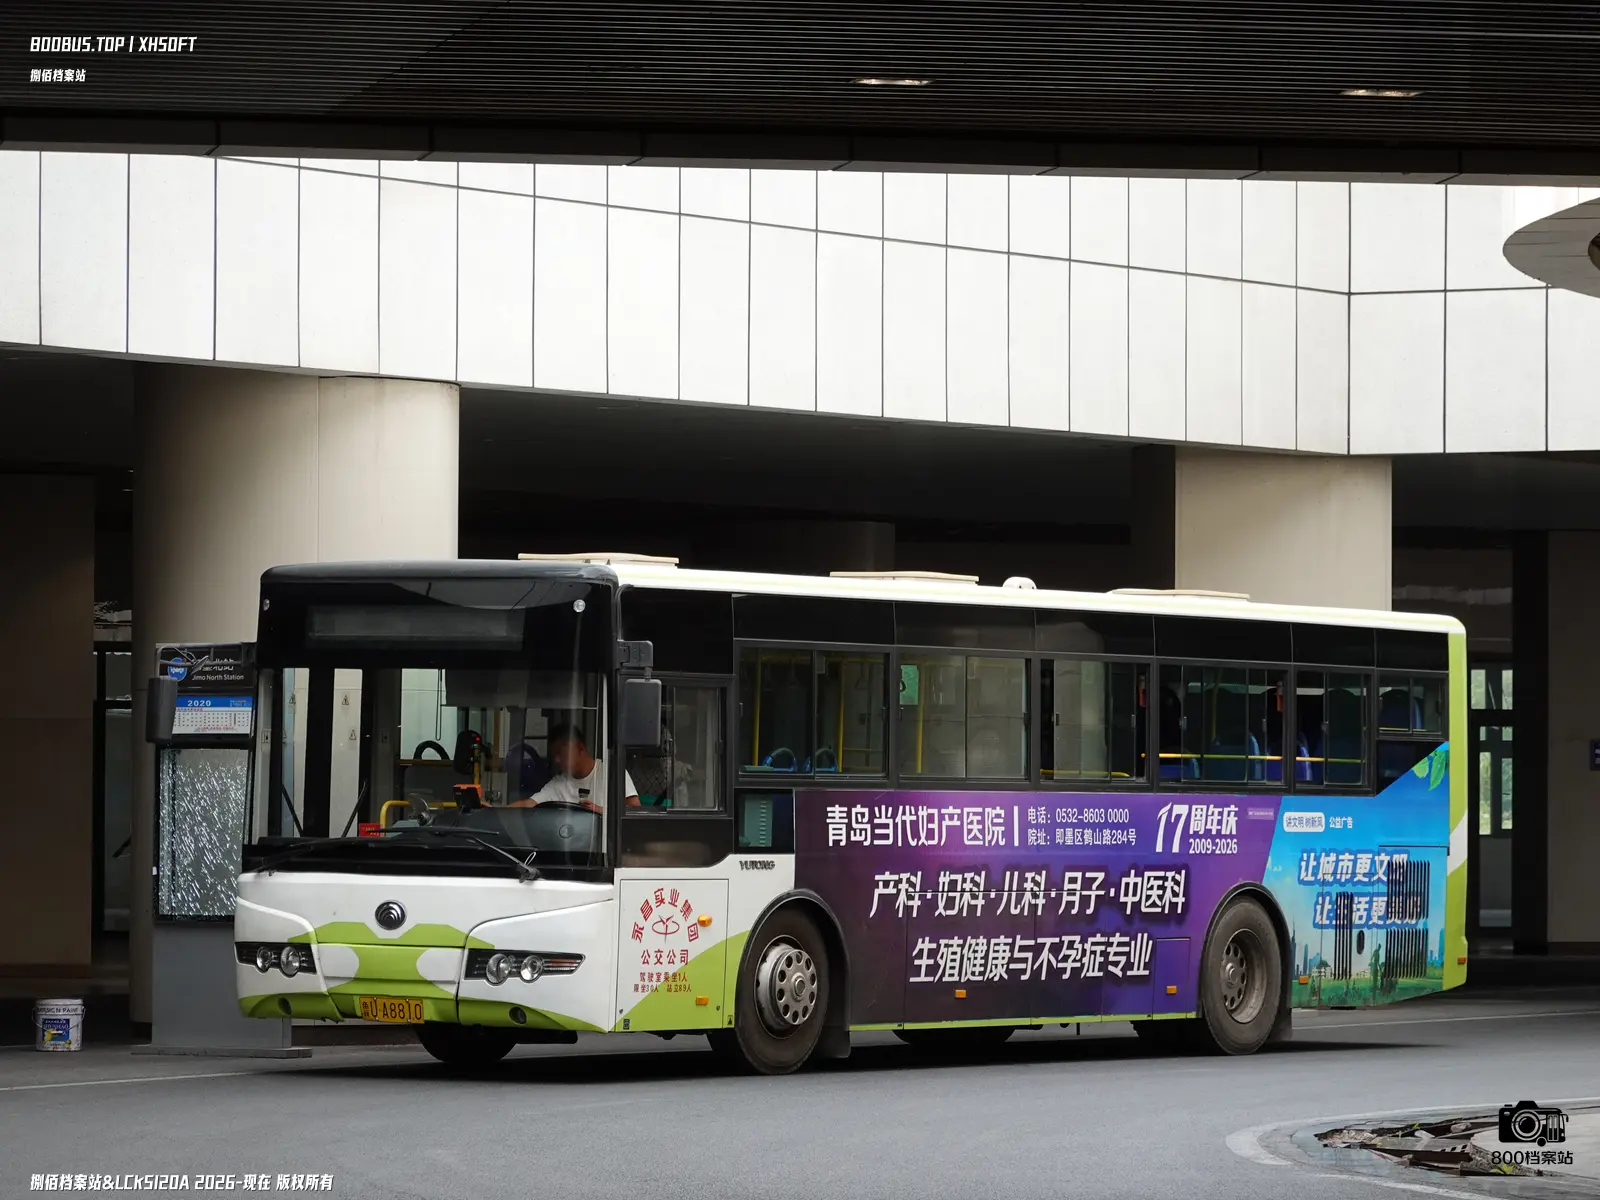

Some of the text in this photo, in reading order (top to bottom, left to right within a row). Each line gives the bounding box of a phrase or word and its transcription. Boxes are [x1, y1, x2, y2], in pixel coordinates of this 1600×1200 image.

[1107, 808, 1130, 824] 0000
[1329, 816, 1354, 829] 公益广告
[825, 804, 1006, 847] 青岛当代妇产医院
[1188, 838, 1239, 855] 2009-2026
[739, 860, 776, 870] YUTONG
[640, 949, 689, 966] 公交公司
[908, 931, 1154, 985] 生殖健康与不孕症专业
